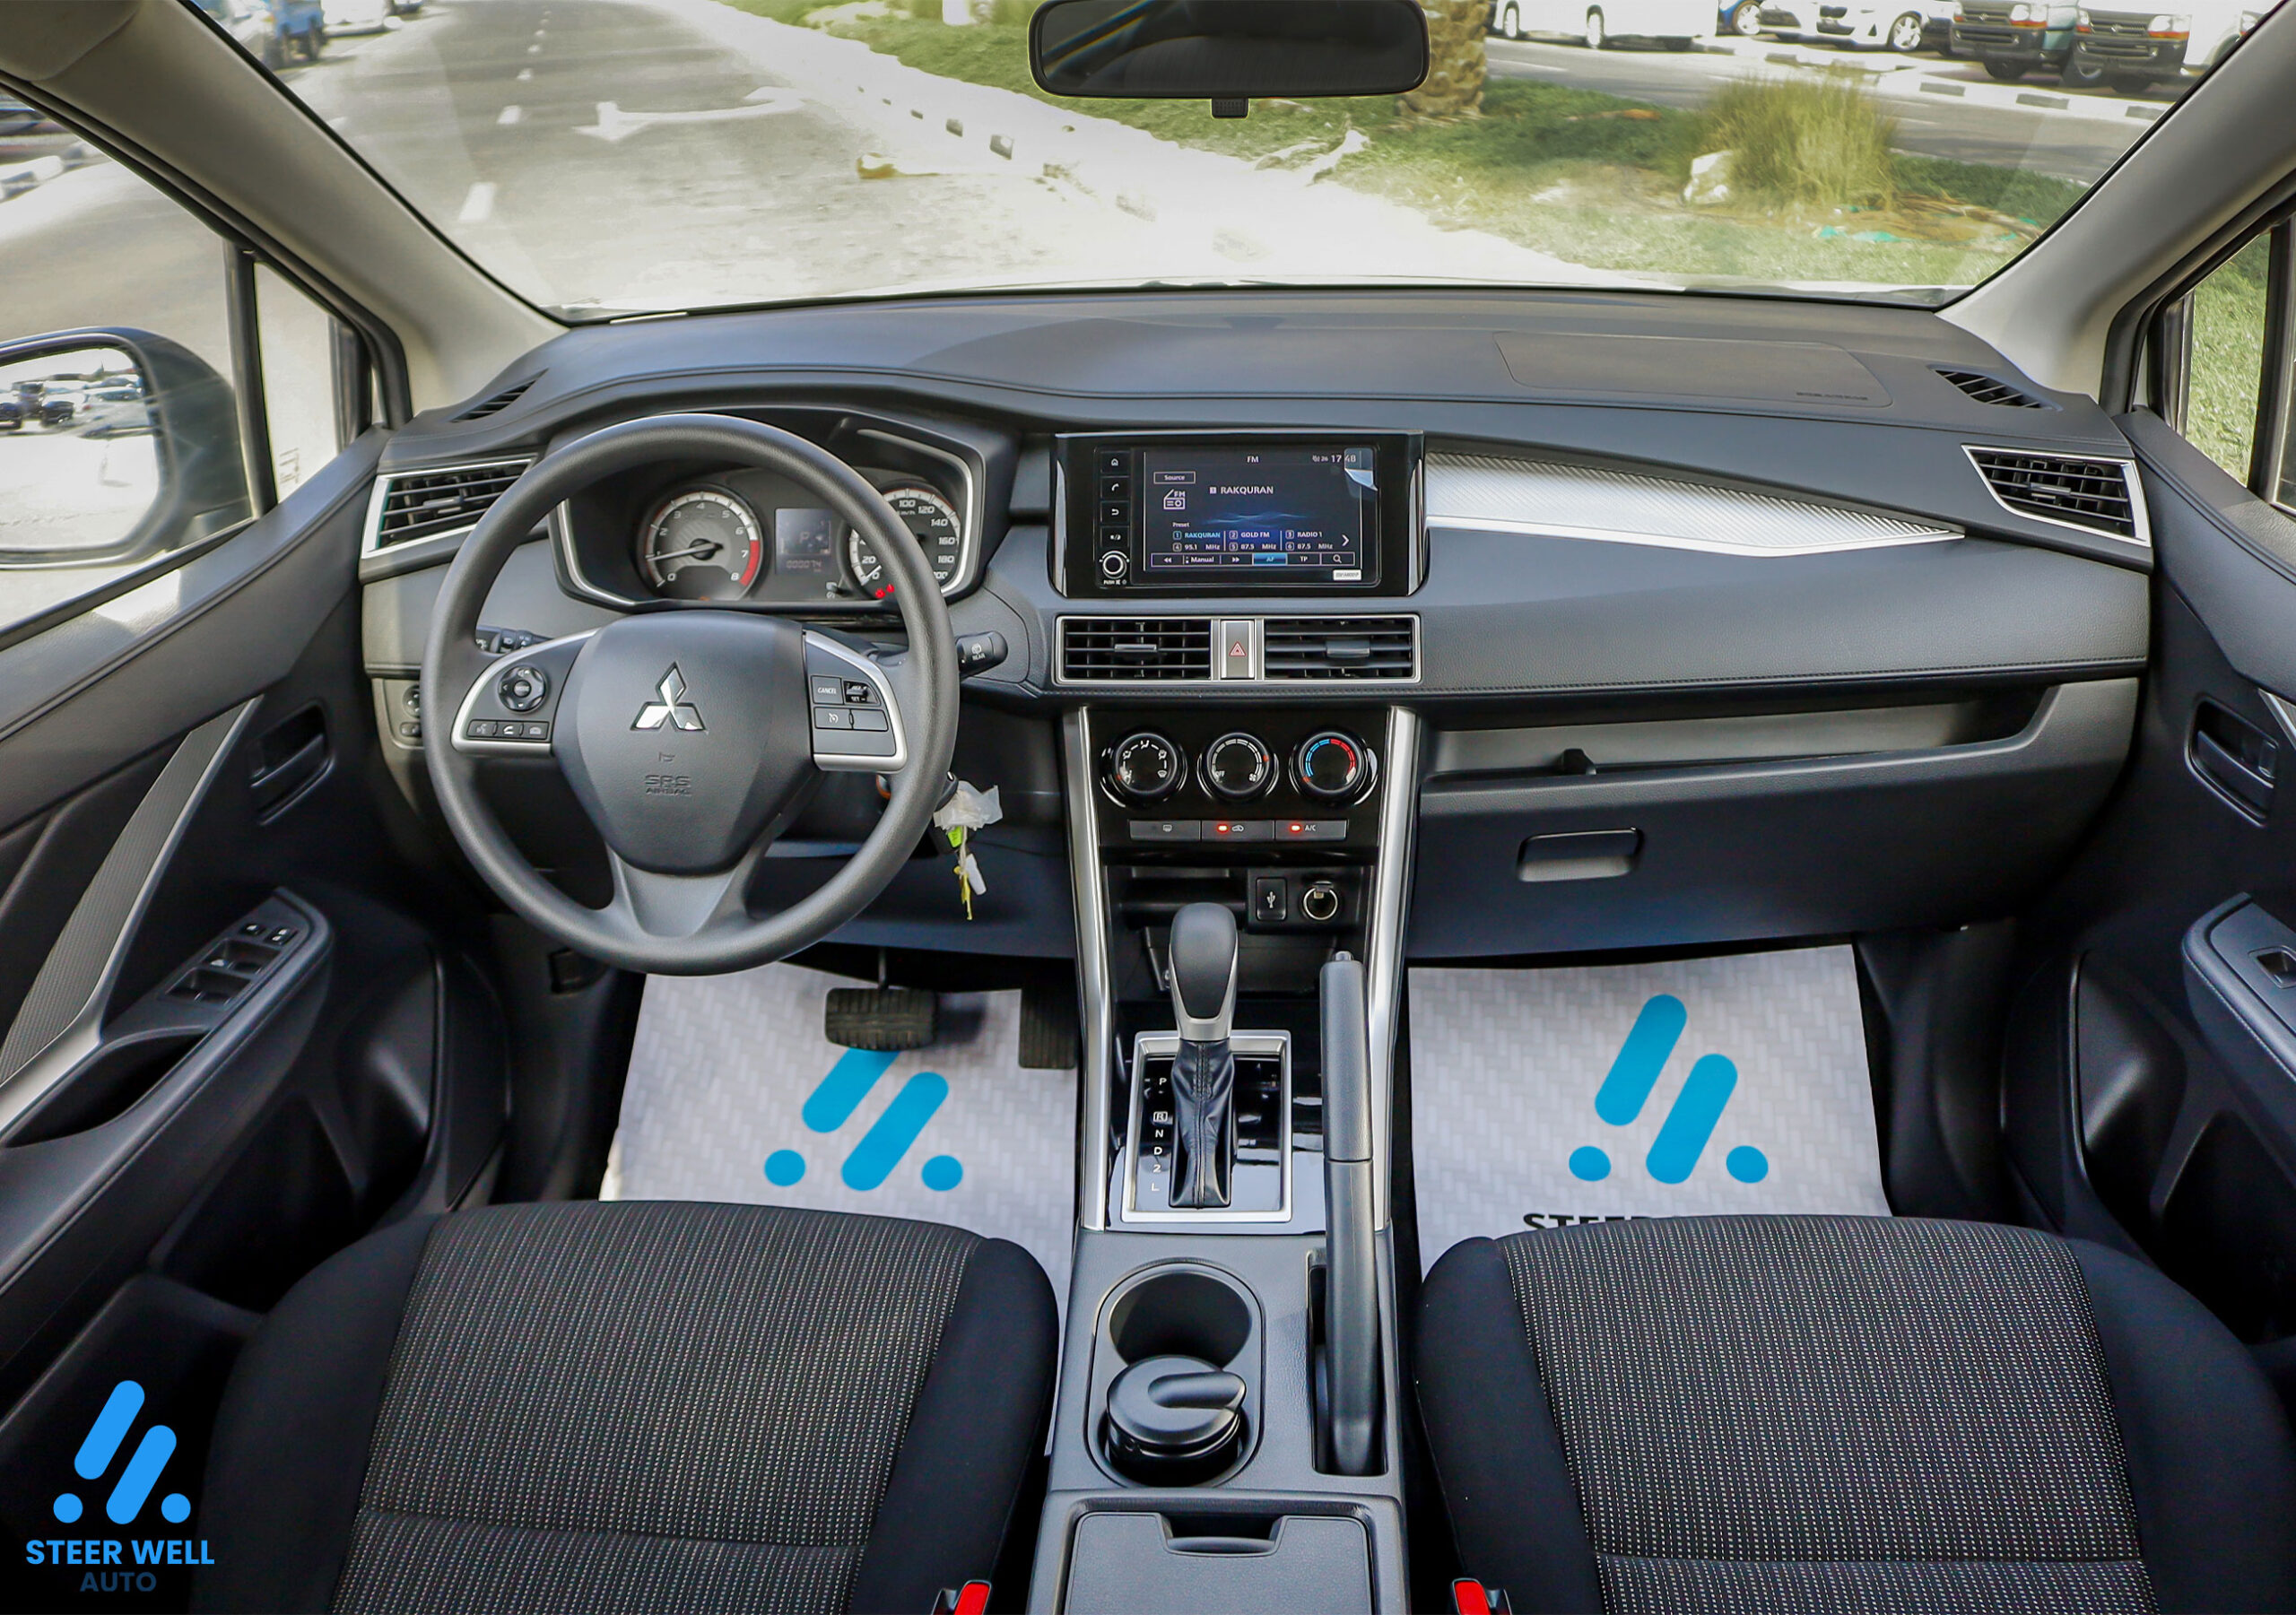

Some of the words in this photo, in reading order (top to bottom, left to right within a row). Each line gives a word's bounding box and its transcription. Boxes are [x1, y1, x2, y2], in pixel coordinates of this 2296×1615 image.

[1221, 486, 1274, 495] RAKQURAN
[696, 502, 705, 510] 4
[899, 499, 916, 508] 100
[673, 509, 682, 519] 3
[722, 509, 731, 518] 5
[918, 506, 935, 515] 120
[931, 518, 948, 527] 140
[659, 527, 669, 536] 2
[735, 526, 744, 535] 6
[938, 537, 955, 545] 160
[741, 550, 749, 559] 7
[937, 555, 955, 563] 180
[861, 556, 876, 564] 20
[666, 572, 676, 581] 0
[730, 572, 740, 581] 8
[817, 687, 837, 695] CANCEL
[1305, 824, 1316, 832] A/C
[1159, 1078, 1167, 1086] P
[1155, 1129, 1164, 1138] N
[1153, 1147, 1162, 1155] D
[1152, 1165, 1161, 1173] 2
[1151, 1183, 1160, 1192] L
